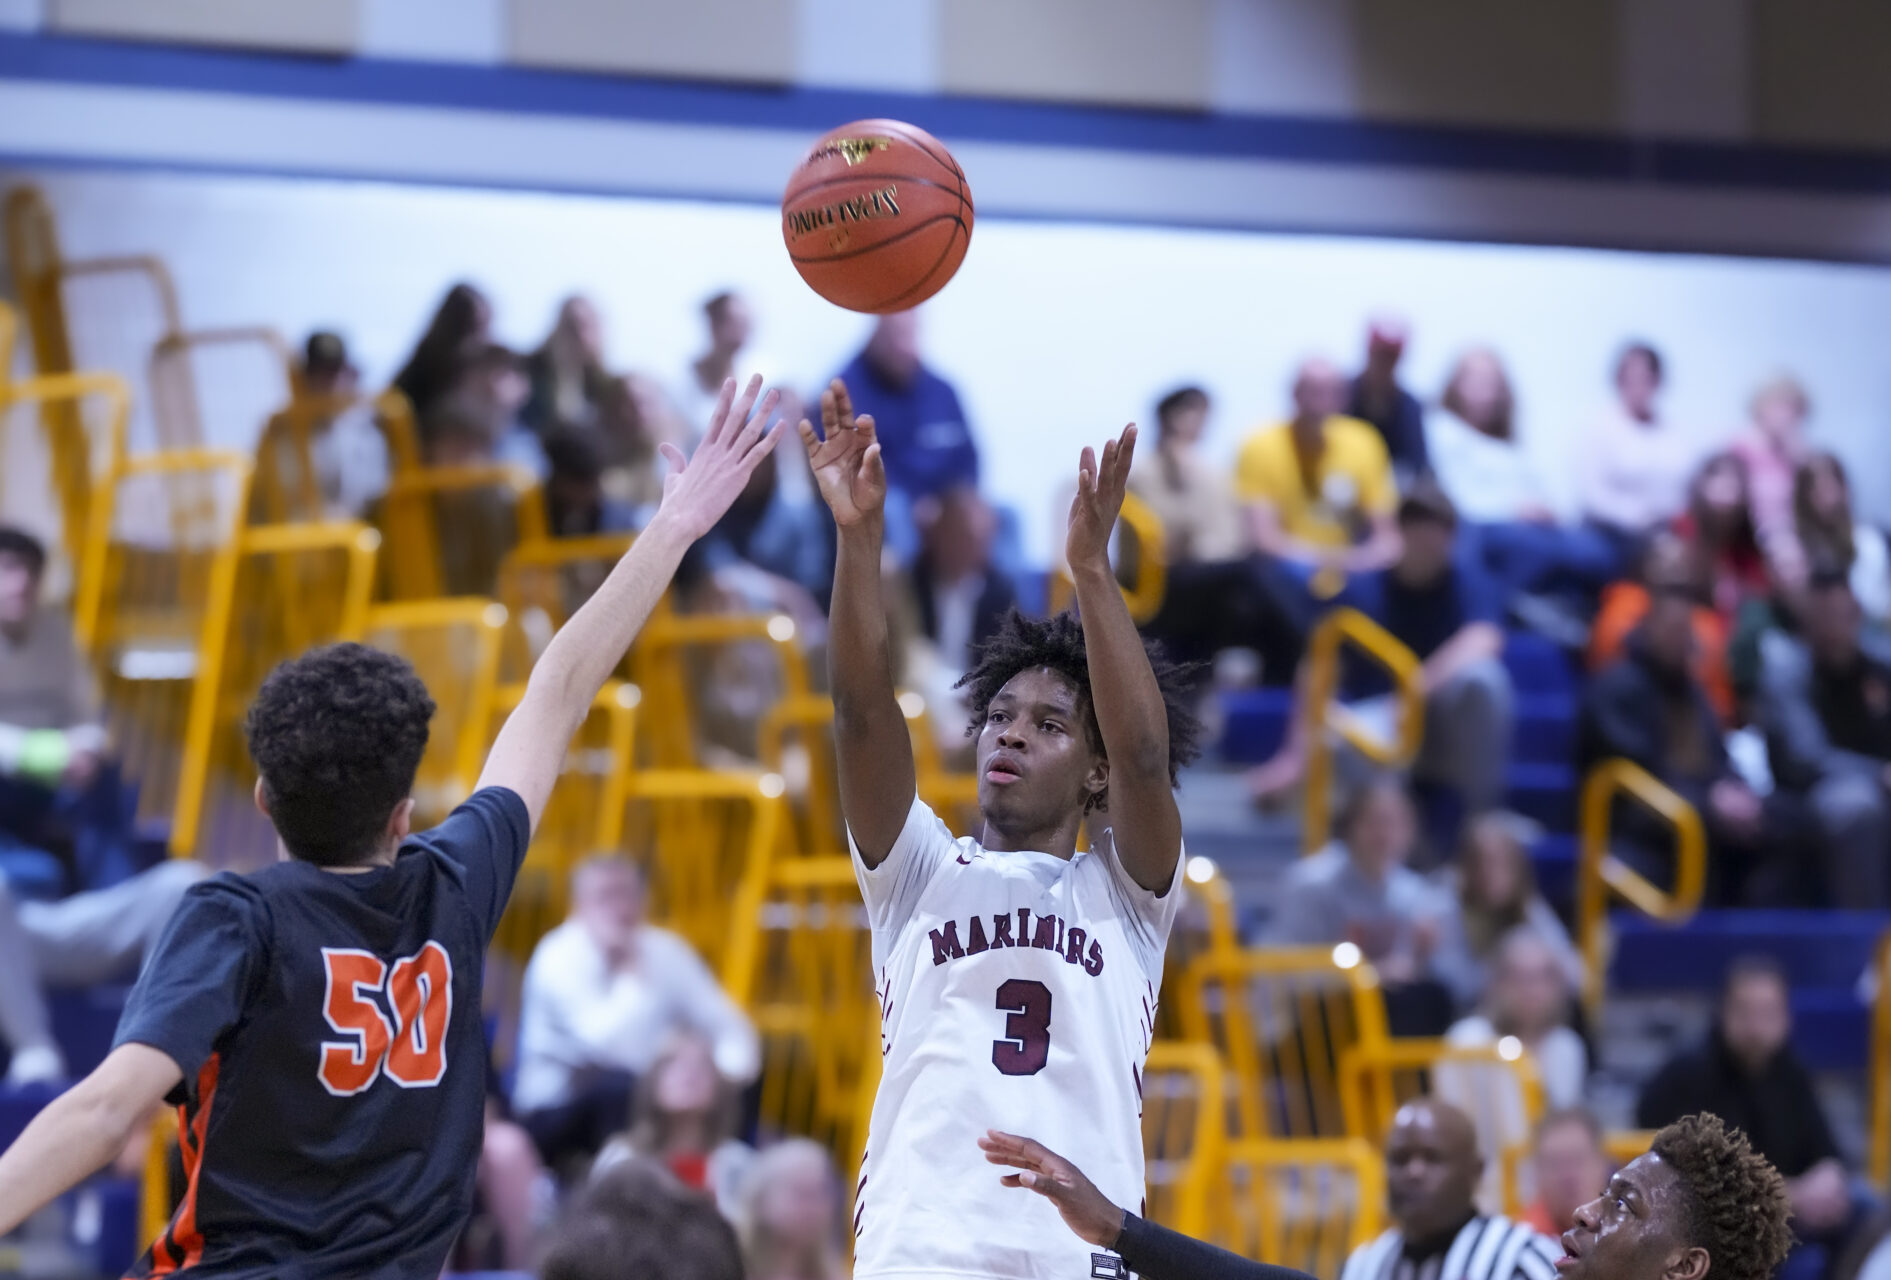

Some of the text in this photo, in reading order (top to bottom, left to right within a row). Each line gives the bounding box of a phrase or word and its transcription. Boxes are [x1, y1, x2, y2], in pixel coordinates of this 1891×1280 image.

[787, 184, 900, 241] SPALDING
[317, 940, 453, 1096] 50
[992, 979, 1052, 1076] 3
